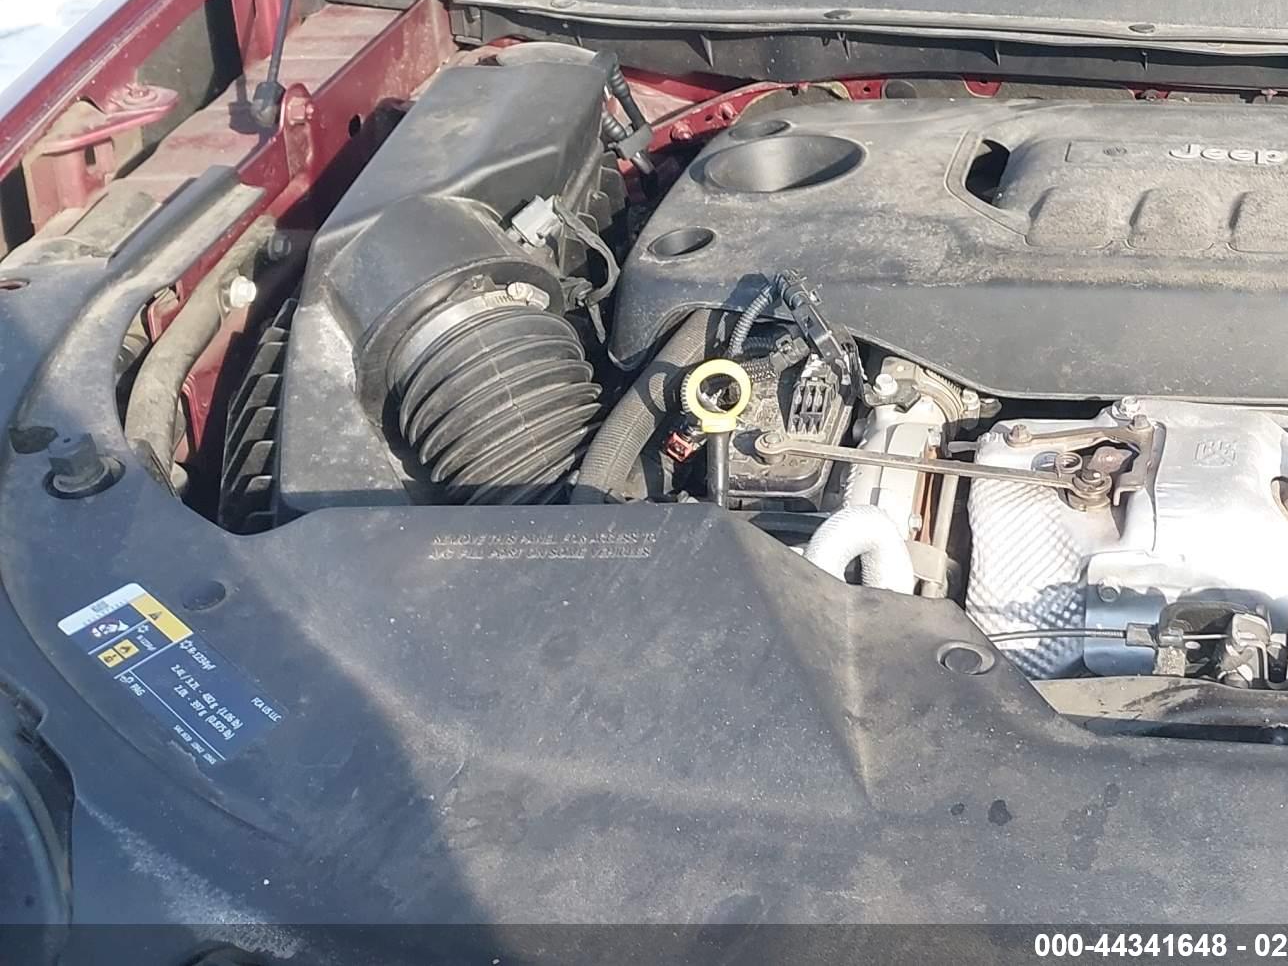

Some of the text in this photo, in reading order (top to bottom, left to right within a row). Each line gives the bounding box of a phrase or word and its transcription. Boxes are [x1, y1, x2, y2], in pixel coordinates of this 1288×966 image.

[1166, 143, 1287, 165] Jeep
[187, 646, 216, 670] R-1234yf
[129, 681, 147, 697] PAG
[250, 696, 282, 722] FCA US LLC
